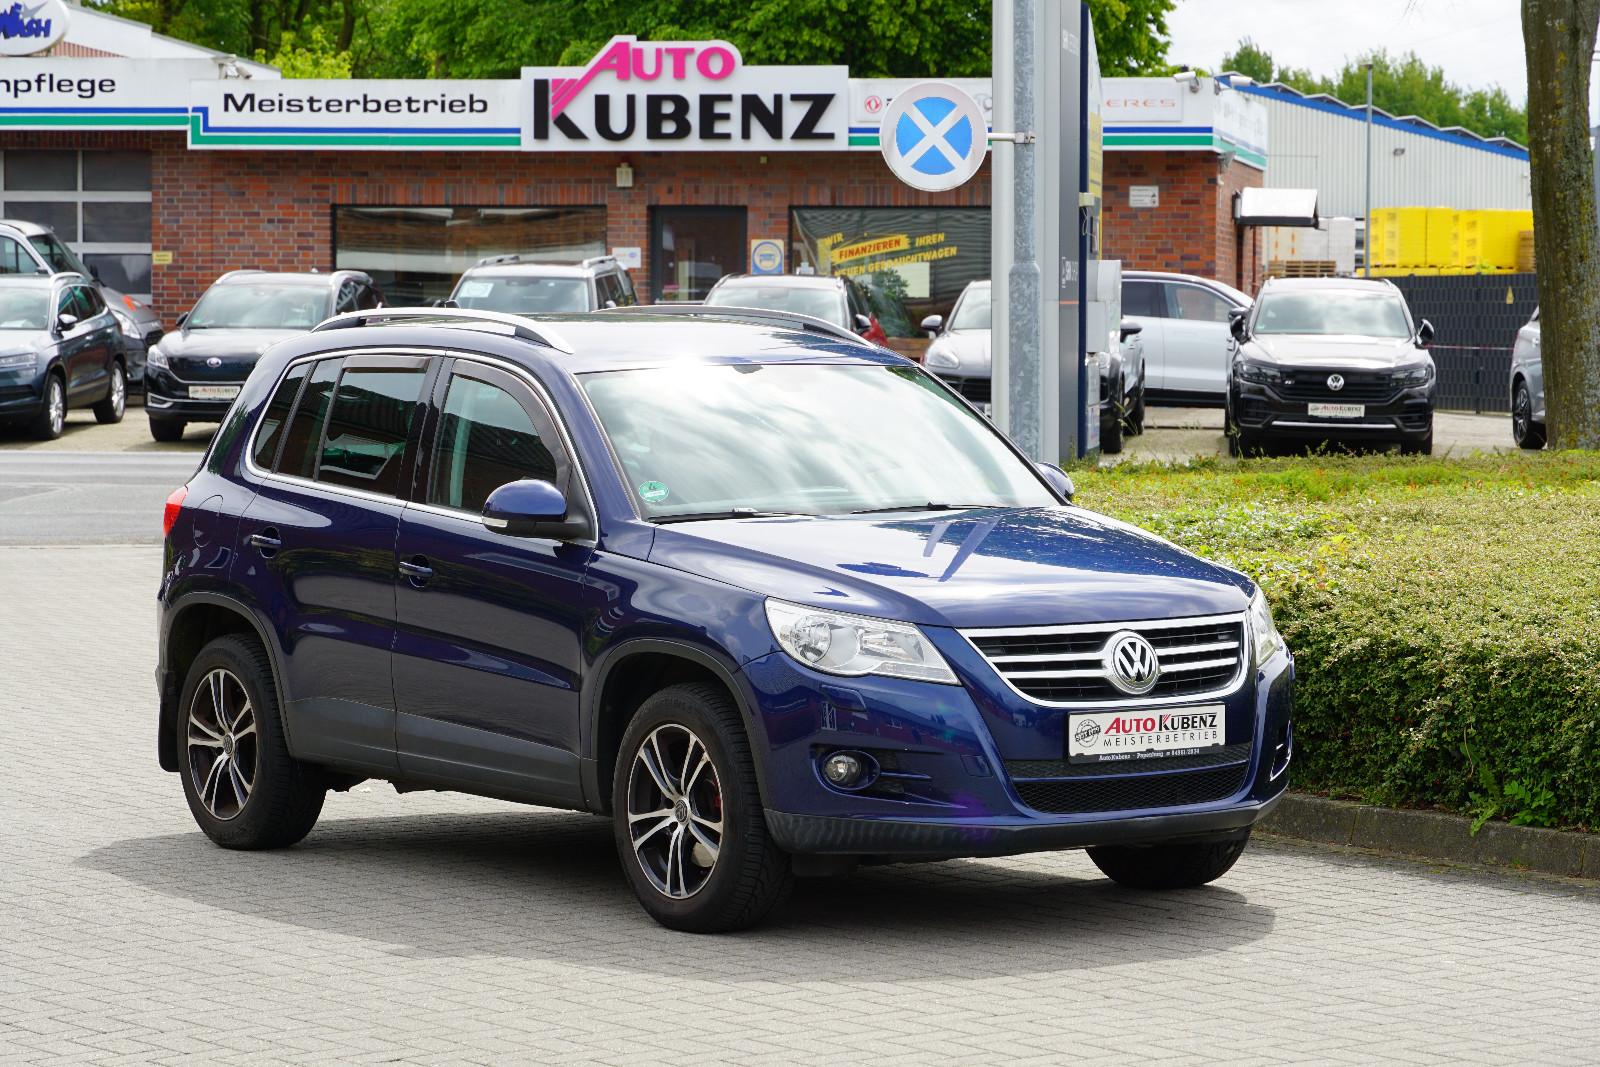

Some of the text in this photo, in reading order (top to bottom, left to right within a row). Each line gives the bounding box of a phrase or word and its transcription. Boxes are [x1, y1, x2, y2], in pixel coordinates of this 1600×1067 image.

[598, 41, 736, 80] AUTO
[0, 73, 117, 99] npflege
[223, 93, 488, 114] Meisterbetrieb
[533, 78, 835, 141] KUBENZ
[839, 233, 945, 259] FINANZIEREN IHREN
[1104, 717, 1156, 735] AUTO
[1158, 713, 1217, 731] KUBENZ
[1103, 731, 1217, 746] MEISTERBETRIEB
